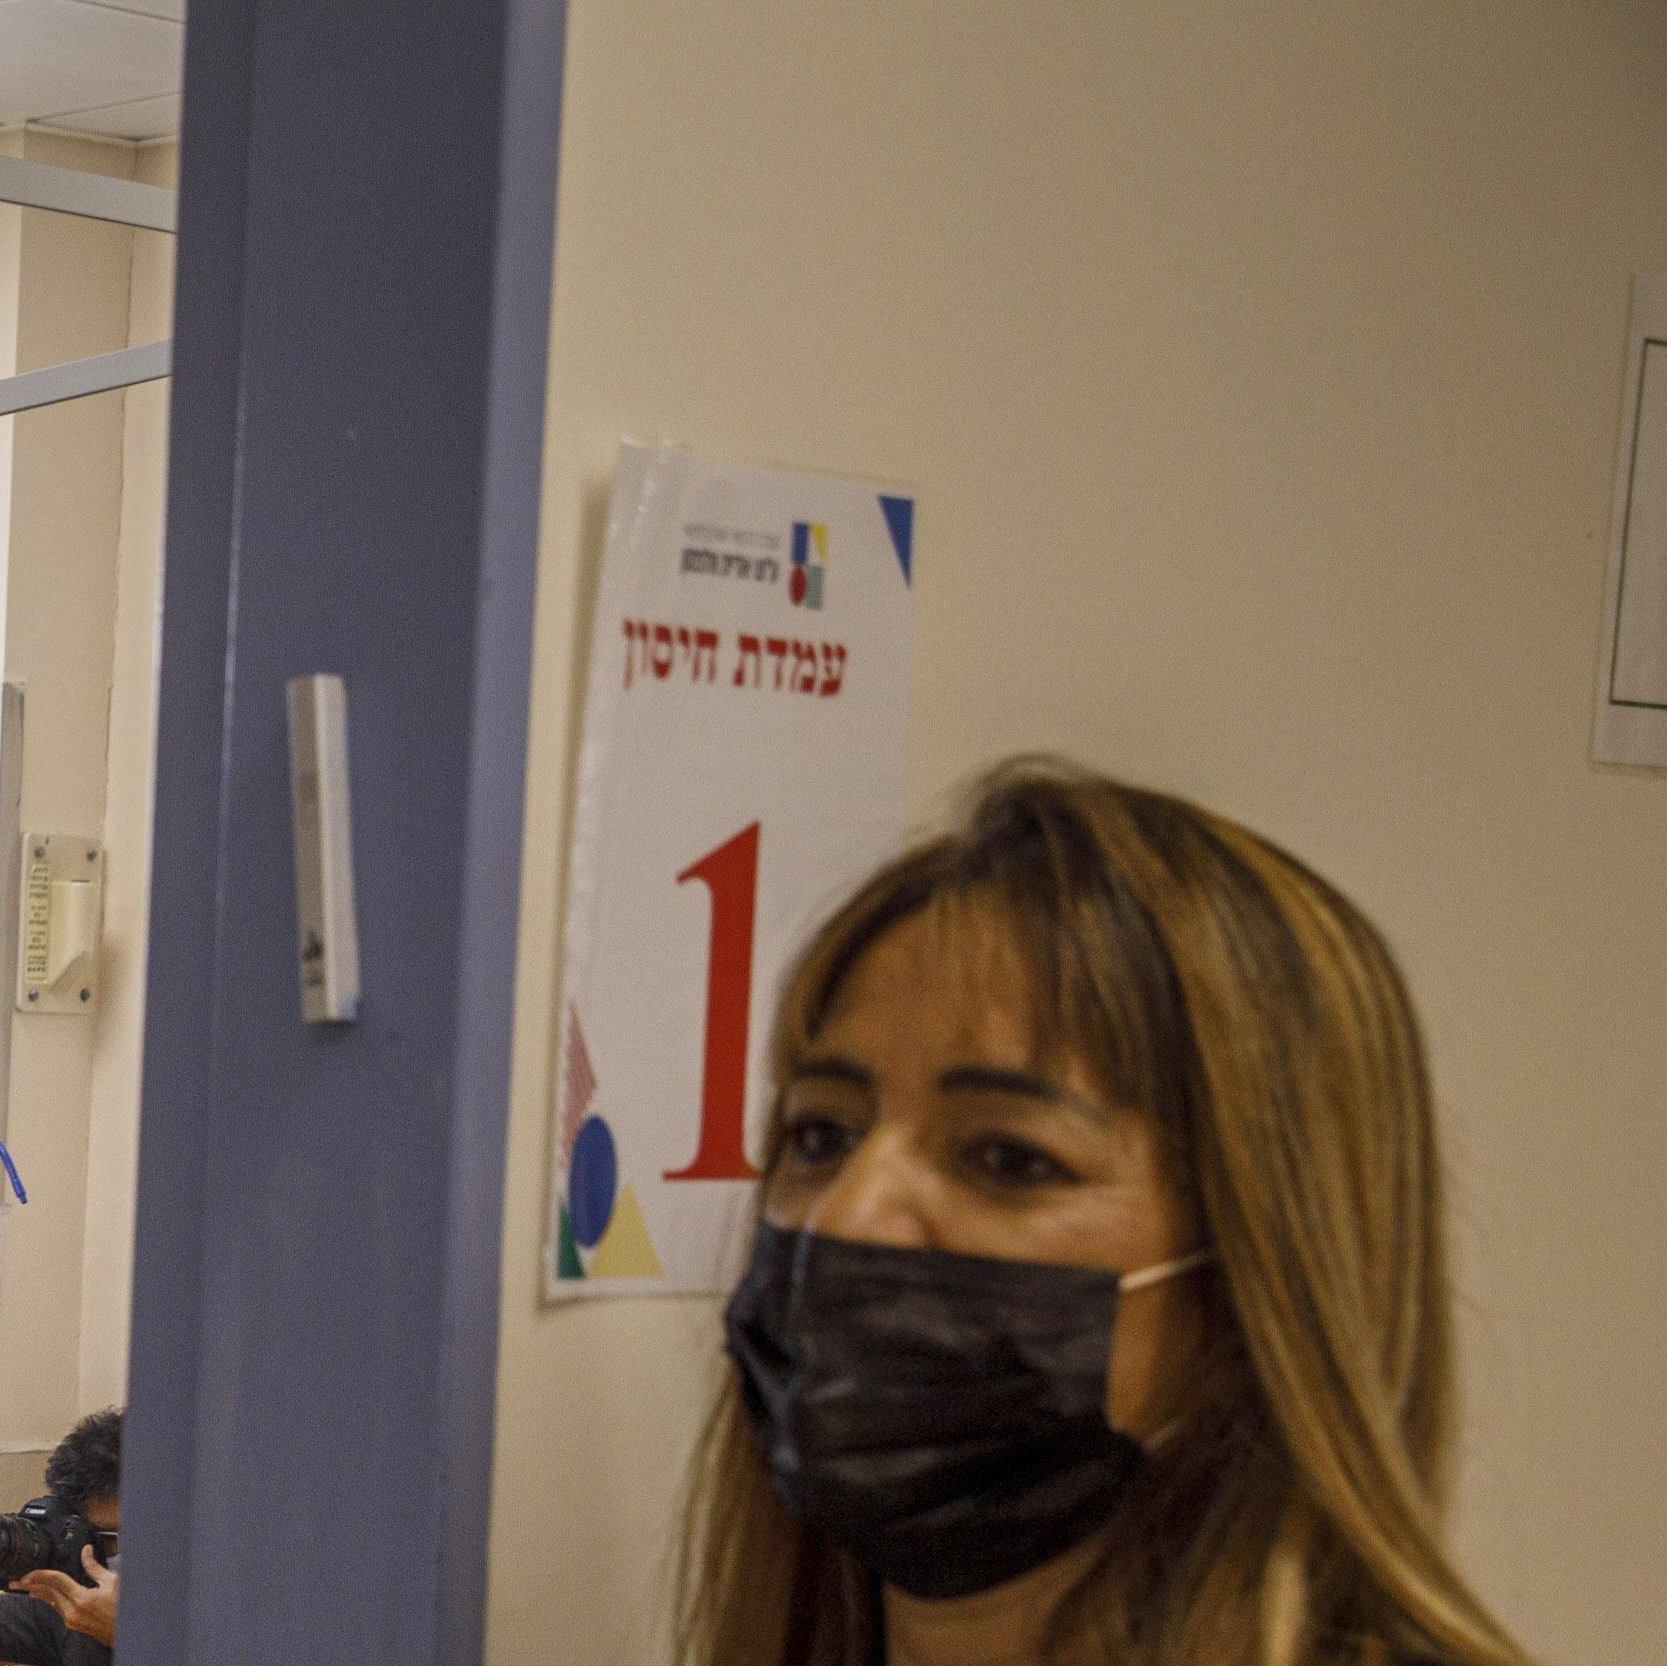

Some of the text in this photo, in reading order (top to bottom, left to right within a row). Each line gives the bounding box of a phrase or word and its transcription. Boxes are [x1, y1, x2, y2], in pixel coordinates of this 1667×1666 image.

[622, 619, 848, 698] עמדת חיסון
[662, 821, 764, 1183] 1
